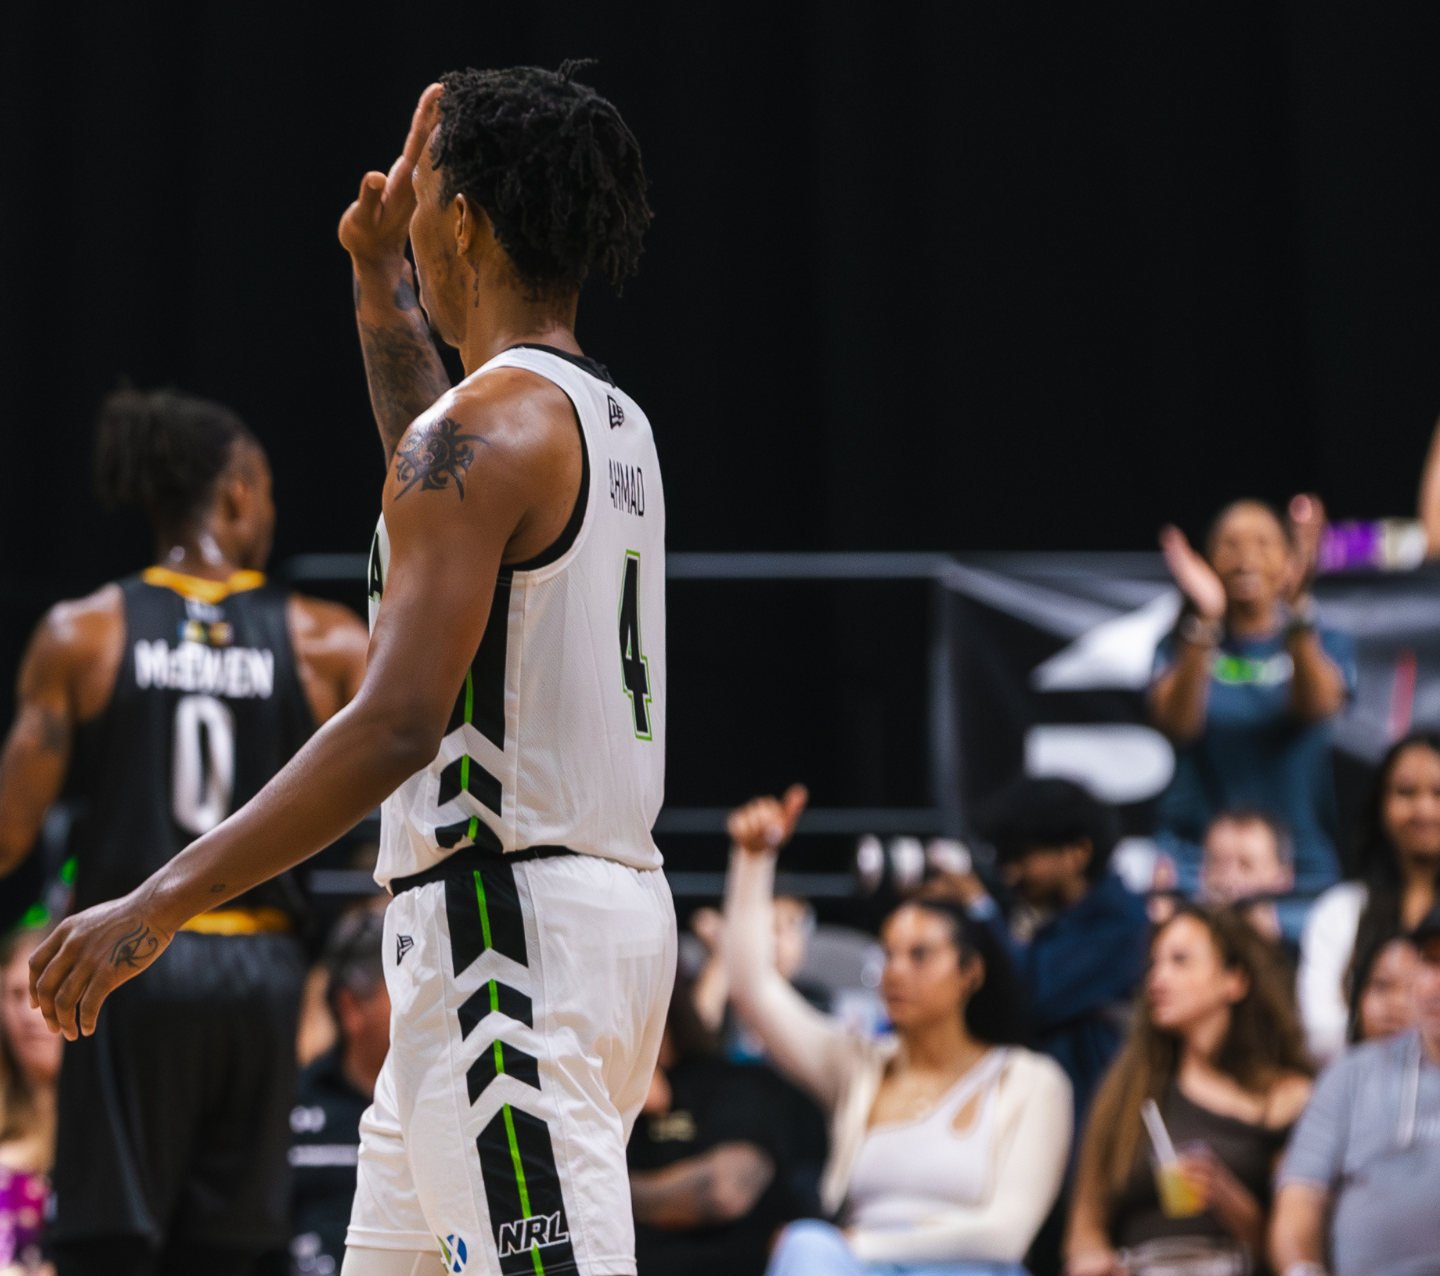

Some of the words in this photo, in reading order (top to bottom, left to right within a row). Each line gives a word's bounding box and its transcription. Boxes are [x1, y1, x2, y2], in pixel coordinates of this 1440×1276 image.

[608, 458, 645, 517] AHMAD
[618, 549, 653, 741] 4
[171, 695, 237, 836] 0
[498, 1210, 570, 1258] NRL
